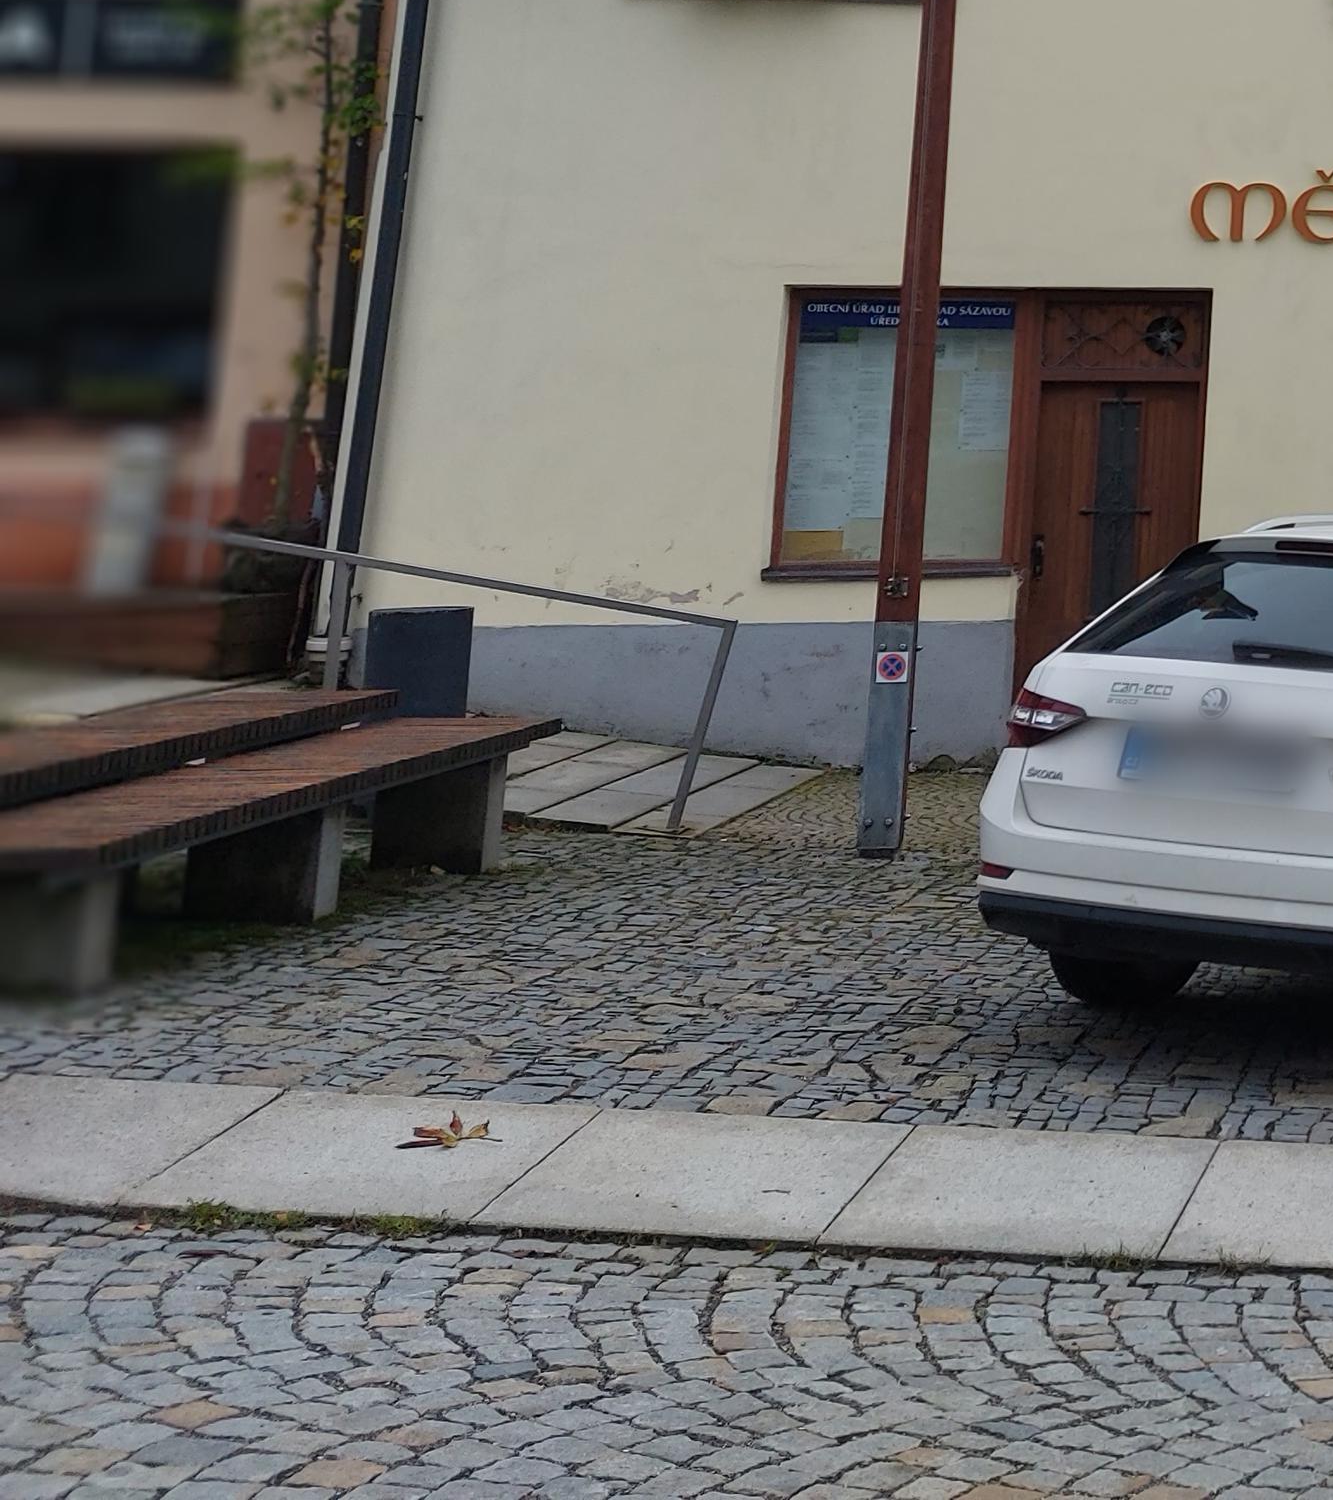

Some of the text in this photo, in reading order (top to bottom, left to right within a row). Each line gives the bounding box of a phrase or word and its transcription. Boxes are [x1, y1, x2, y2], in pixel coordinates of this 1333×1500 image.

[852, 303, 884, 314] ÚŘAD
[959, 304, 1011, 316] SÁZAVOU
[870, 315, 899, 326] ÚŘED
